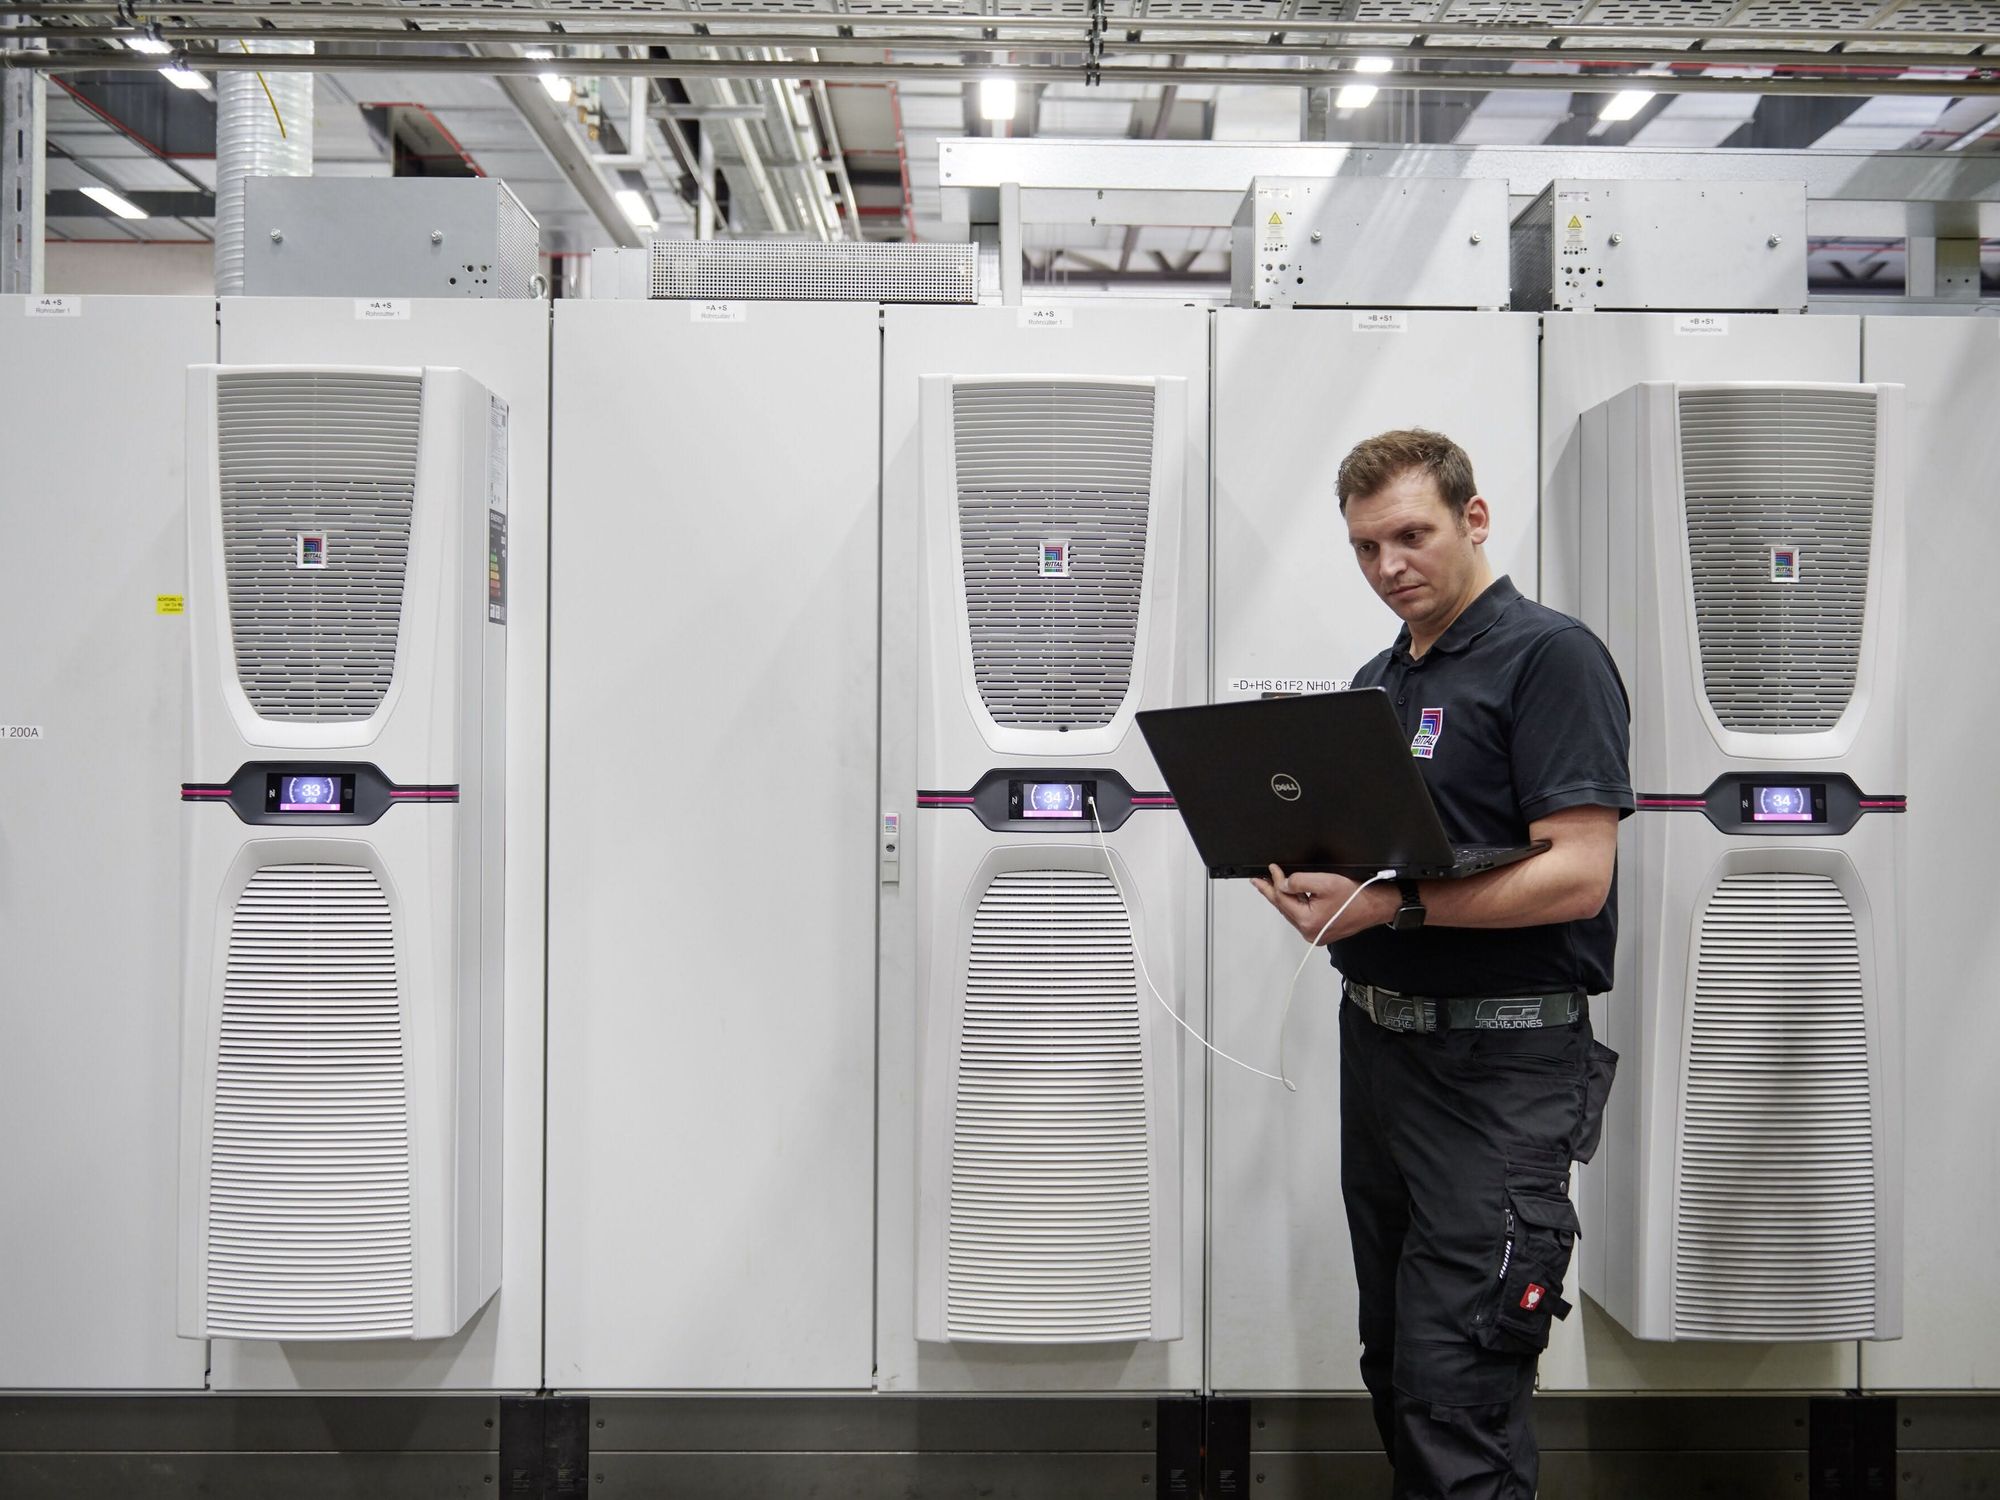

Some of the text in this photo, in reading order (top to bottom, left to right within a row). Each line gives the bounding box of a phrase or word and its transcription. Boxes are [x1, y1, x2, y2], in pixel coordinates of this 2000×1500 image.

[1233, 680, 1272, 690] =D+HS
[1275, 681, 1303, 691] 61F2
[1307, 681, 1336, 691] NH01
[10, 727, 39, 737] 200A
[302, 784, 321, 796] 33
[1044, 791, 1062, 803] 34
[1773, 794, 1791, 807] 34
